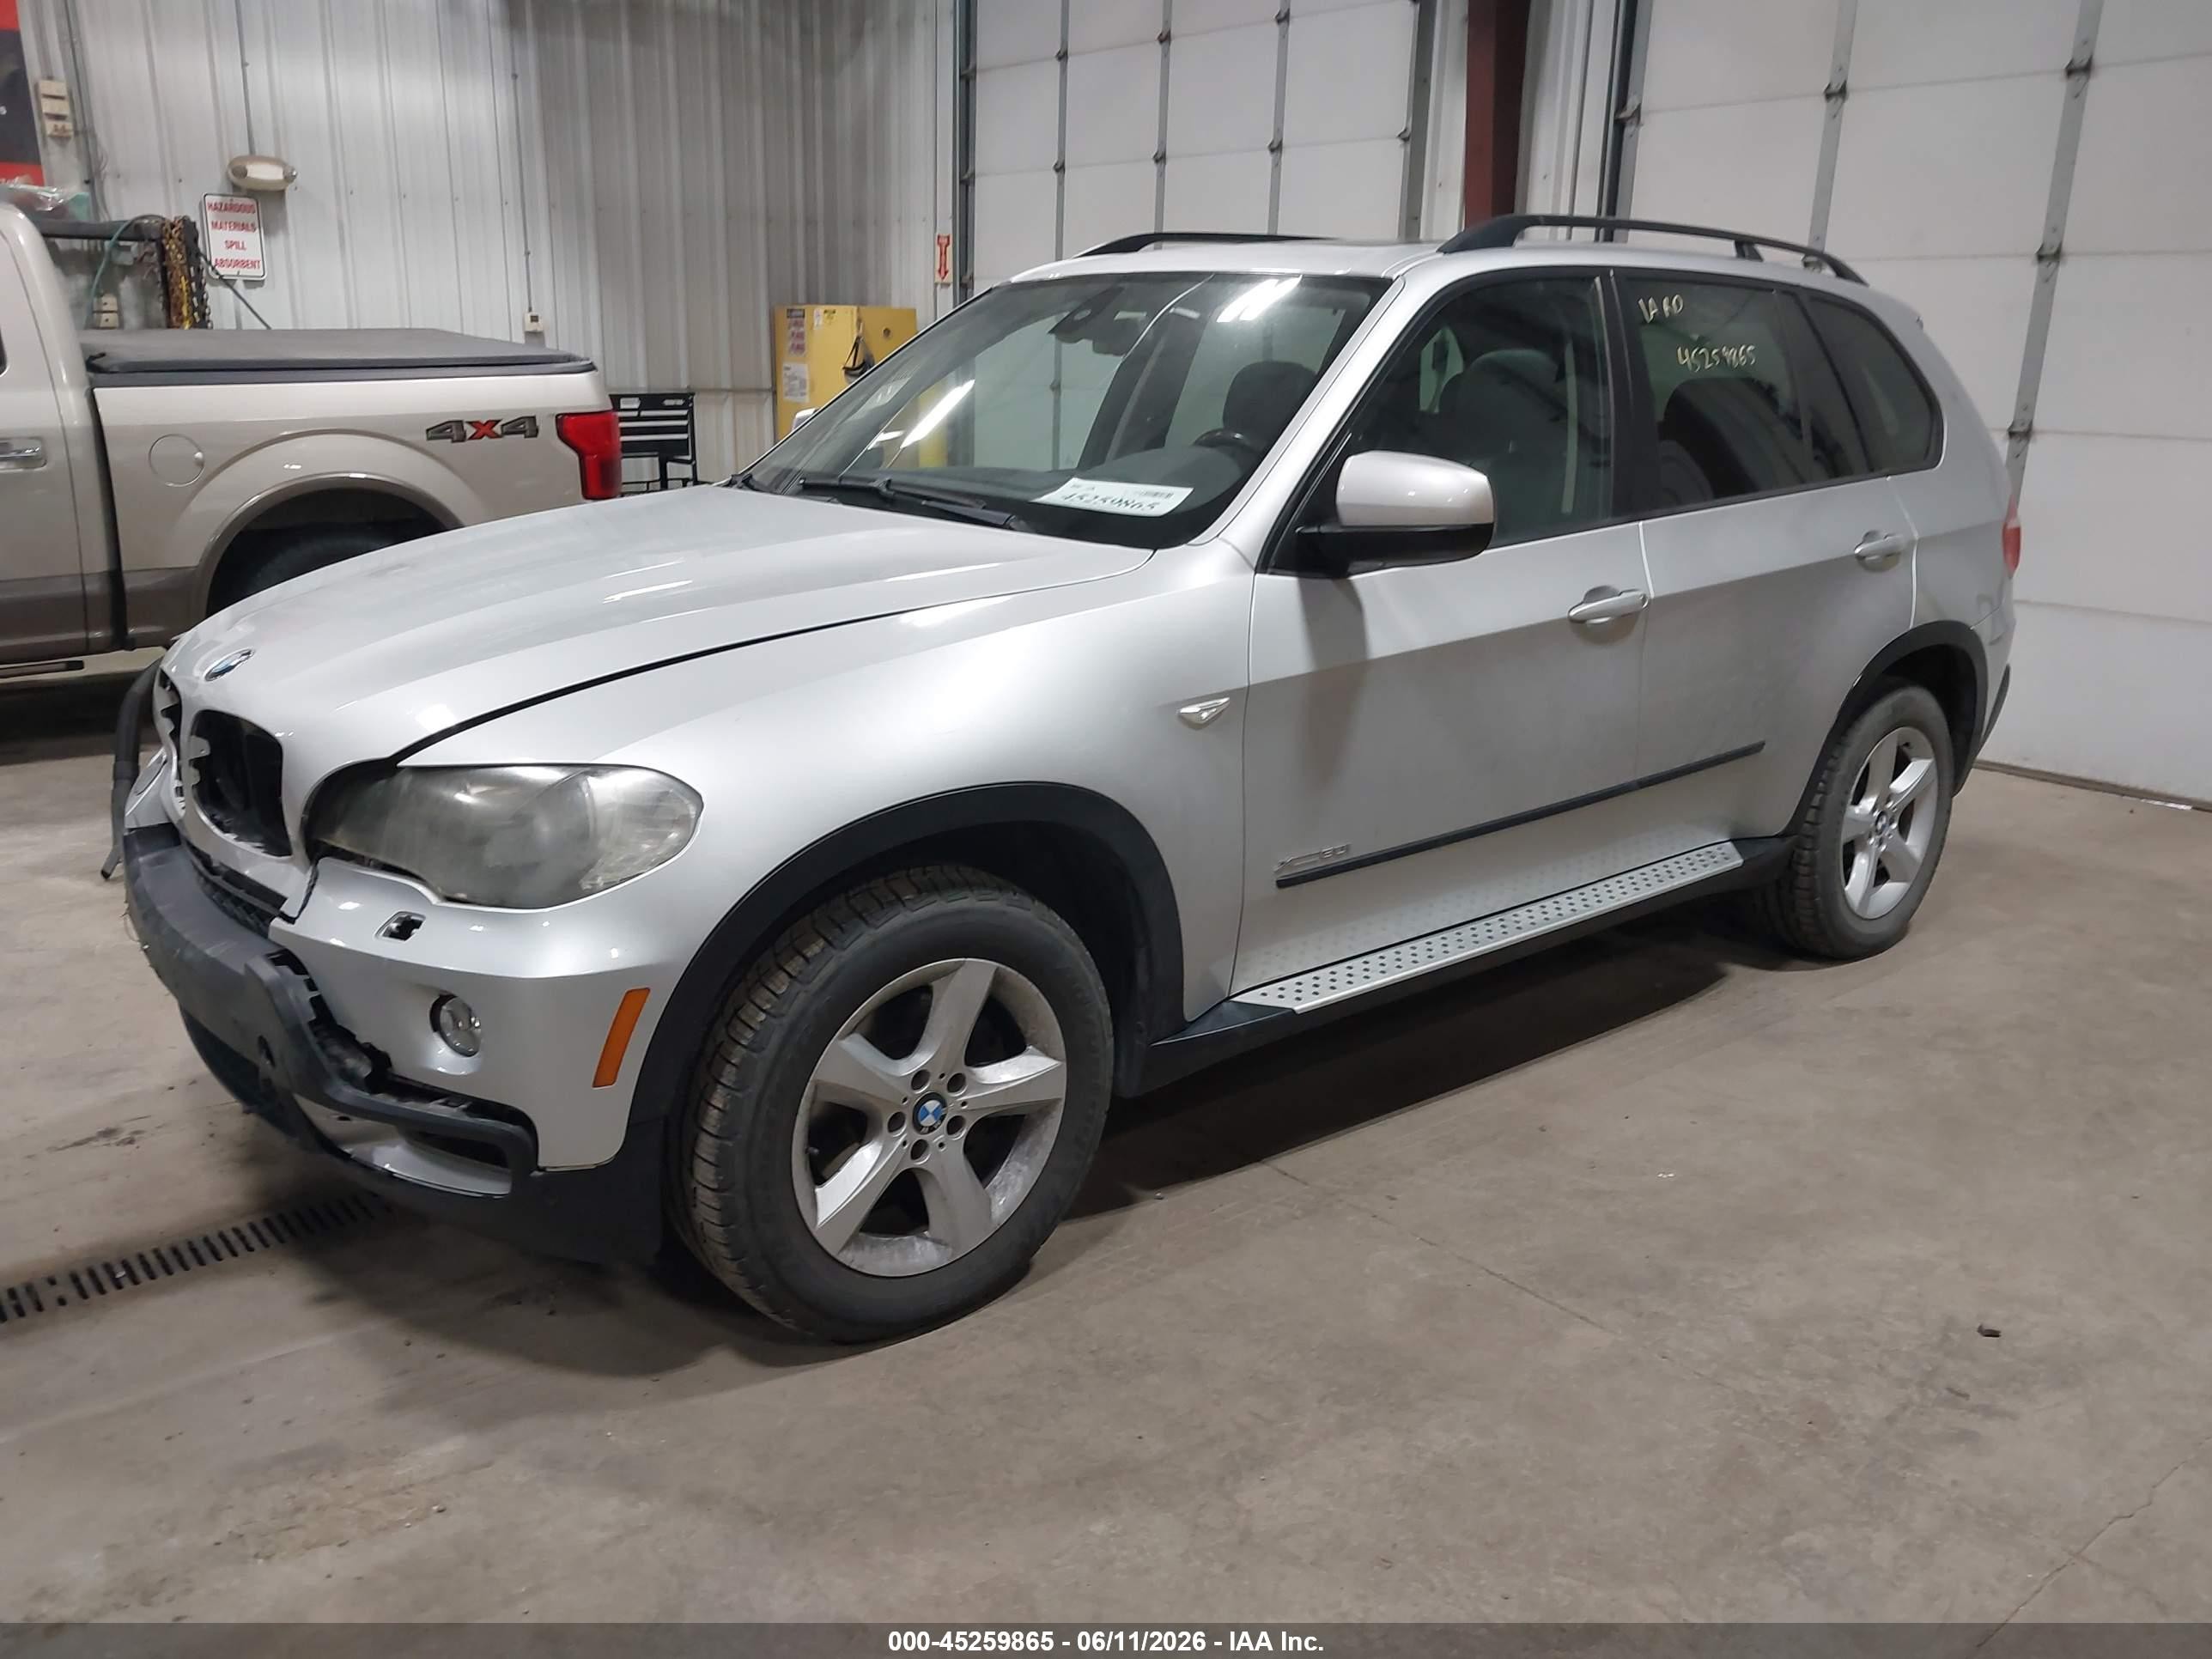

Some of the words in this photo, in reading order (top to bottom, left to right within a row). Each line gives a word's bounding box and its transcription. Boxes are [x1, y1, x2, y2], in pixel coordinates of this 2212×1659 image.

[207, 202, 256, 215] HAZARDOUS
[211, 221, 257, 232] MATERIALS
[225, 240, 247, 251] SPILL
[214, 258, 261, 270] ABSORBENT
